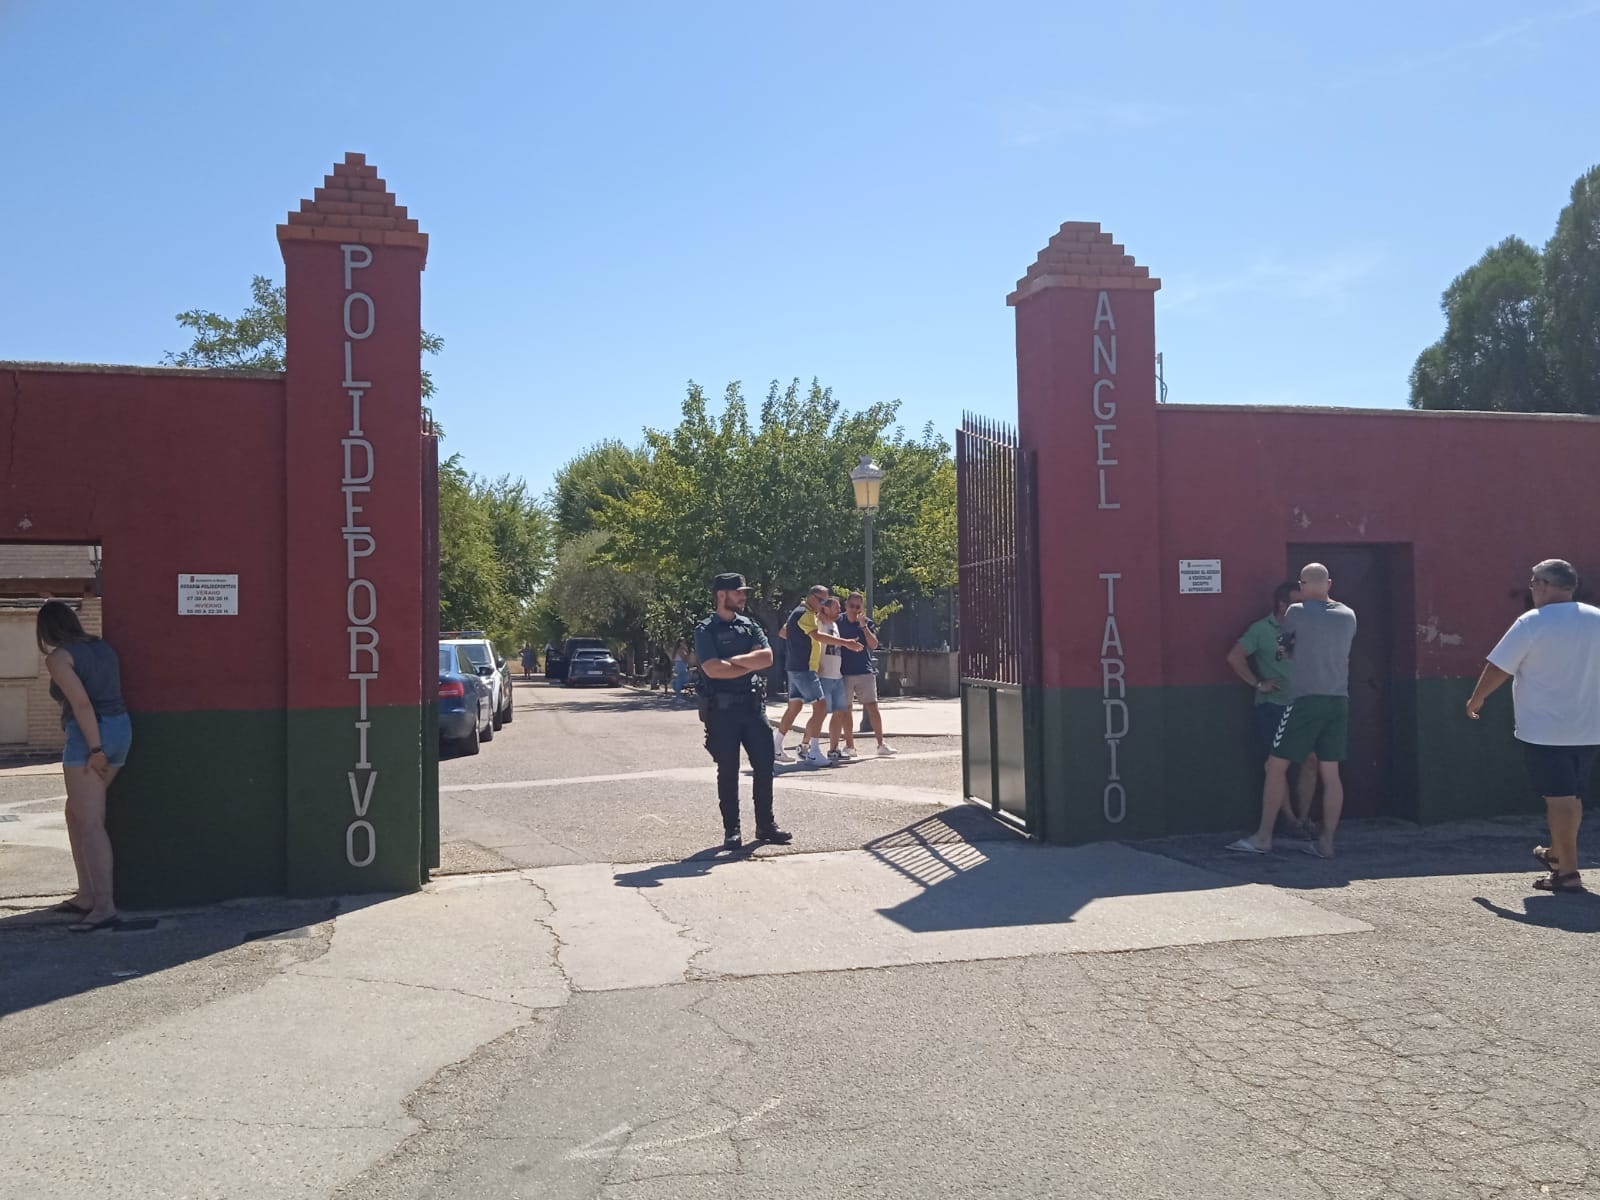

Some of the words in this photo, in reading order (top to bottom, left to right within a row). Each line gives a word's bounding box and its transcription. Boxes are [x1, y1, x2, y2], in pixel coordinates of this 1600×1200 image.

[1093, 291, 1121, 509] ANGEL
[339, 243, 380, 868] POLIDEPORTIVO
[1099, 573, 1129, 823] TARDIO
